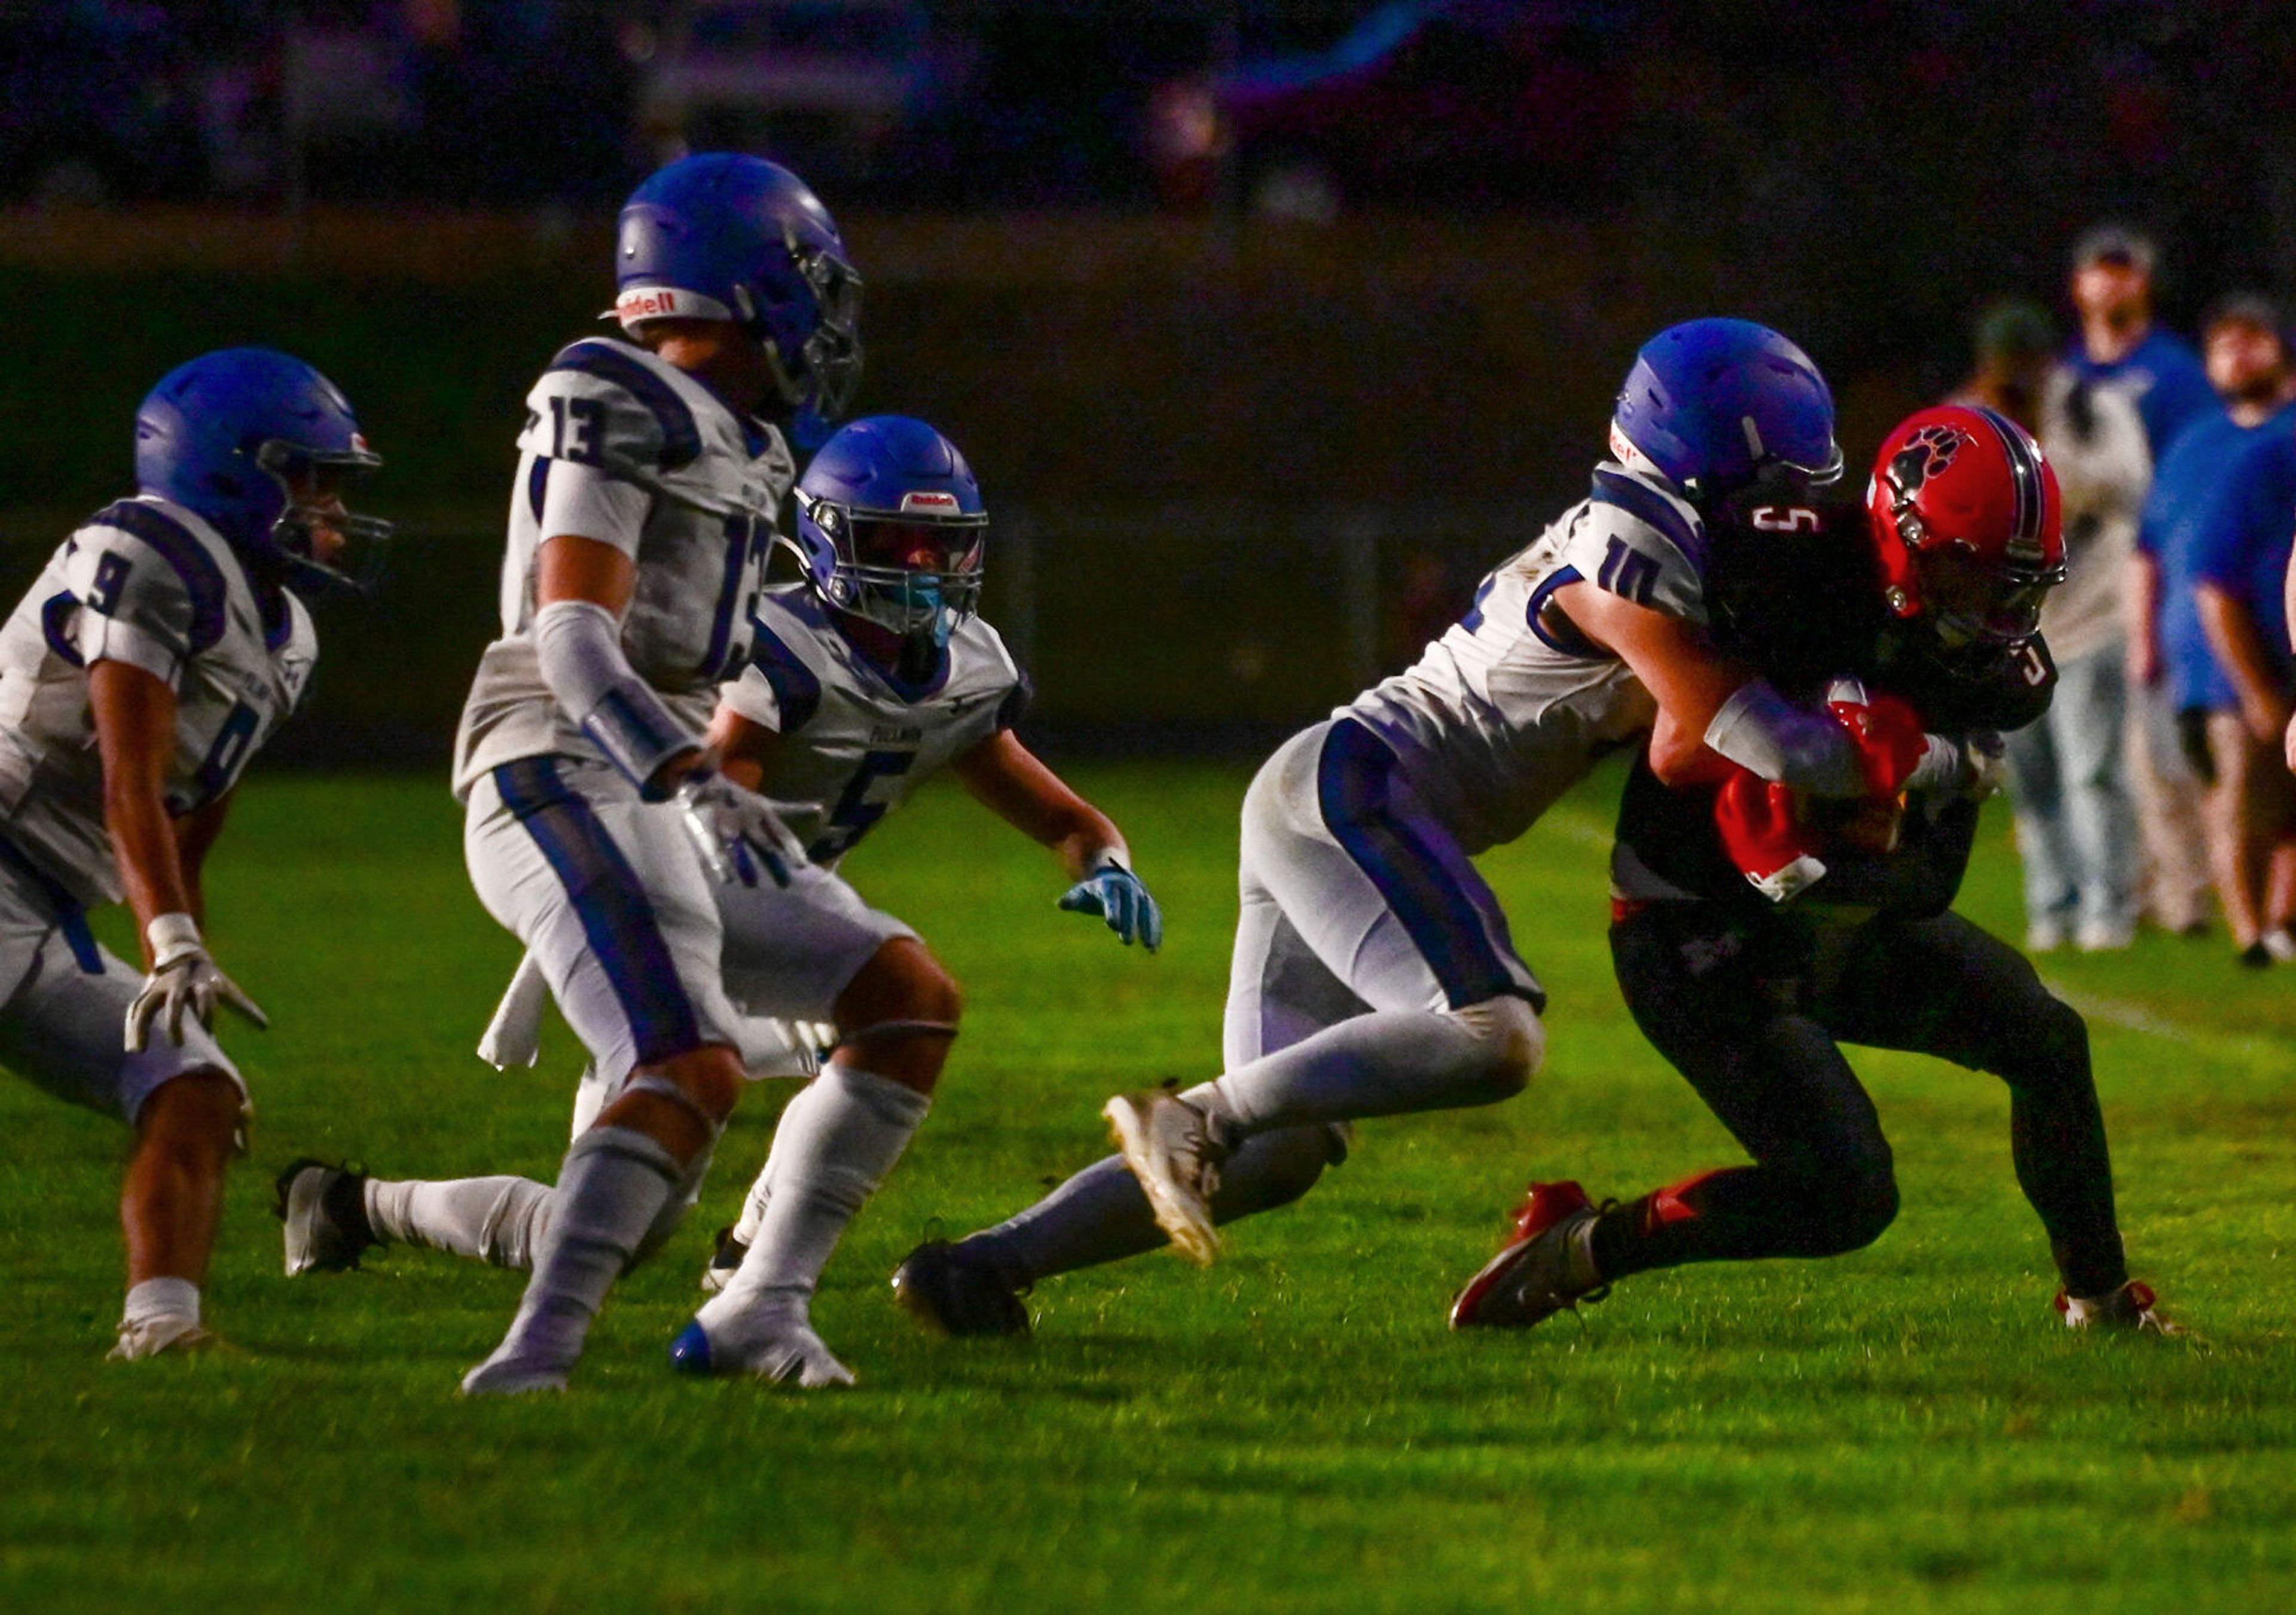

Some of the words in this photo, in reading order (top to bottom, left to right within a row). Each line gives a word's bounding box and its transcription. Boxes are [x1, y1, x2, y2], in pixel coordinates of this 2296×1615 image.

[549, 396, 604, 468] 13
[1752, 506, 1819, 534] 5
[88, 551, 133, 616] 9
[807, 752, 916, 862] 5
